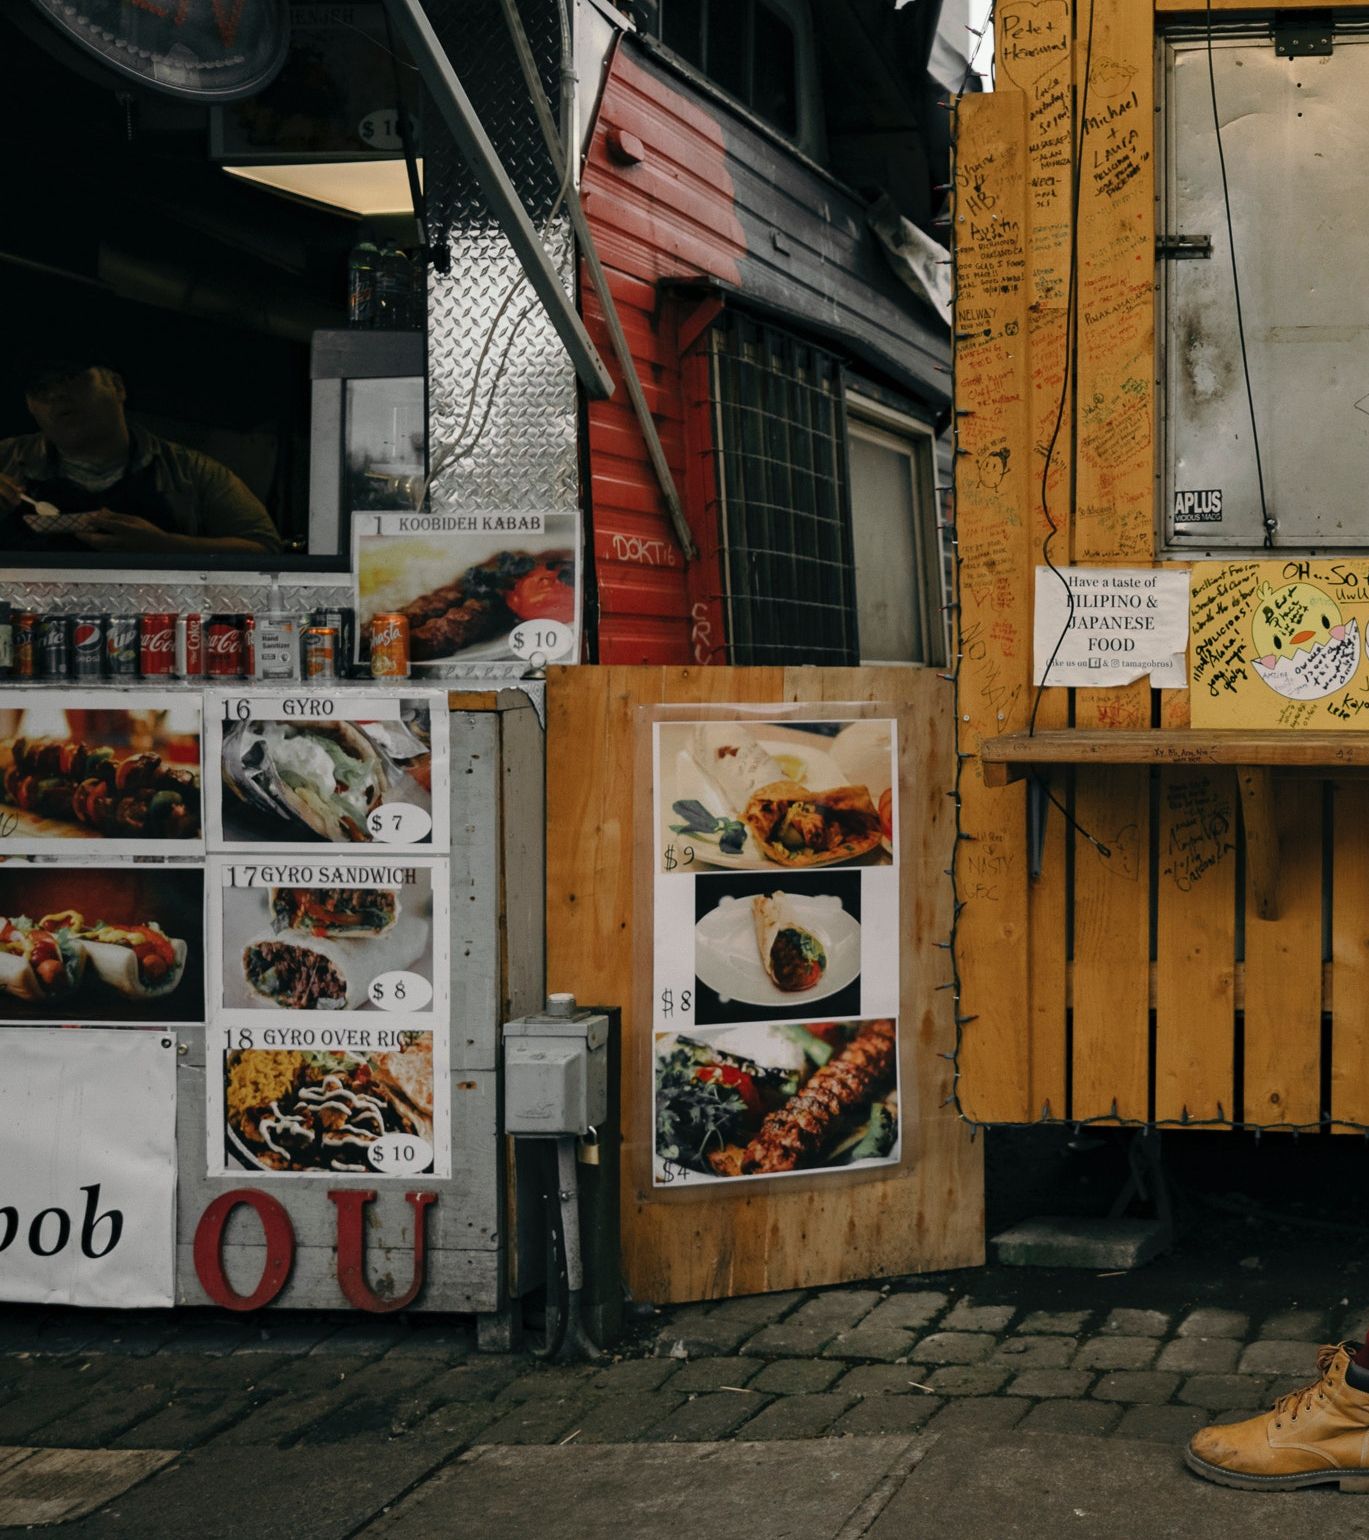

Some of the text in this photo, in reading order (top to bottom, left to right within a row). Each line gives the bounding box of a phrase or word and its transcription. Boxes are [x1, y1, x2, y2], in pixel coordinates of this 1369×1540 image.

[1083, 91, 1138, 135] Michael
[1175, 490, 1222, 515] APLUS
[400, 516, 478, 531] KOOBIDEH
[482, 516, 541, 530] KABAB
[1068, 576, 1158, 588] Have a taste of
[1146, 596, 1158, 608] &
[1069, 616, 1156, 631] JAPANESE
[262, 642, 290, 650] Sanitizer
[536, 631, 557, 648] 10
[1088, 637, 1135, 651] FOOD
[1066, 660, 1076, 668] us
[222, 699, 335, 720] 16 GYRO
[371, 814, 403, 832] $ 7
[683, 845, 696, 866] 9
[227, 866, 416, 888] 17 GYRO SANDWICH
[372, 982, 406, 1000] $ 8
[680, 989, 692, 1012] 8
[224, 1028, 254, 1050] 18
[263, 1028, 315, 1046] GYRO
[321, 1029, 370, 1046] OVER
[372, 1145, 415, 1163] $ 10
